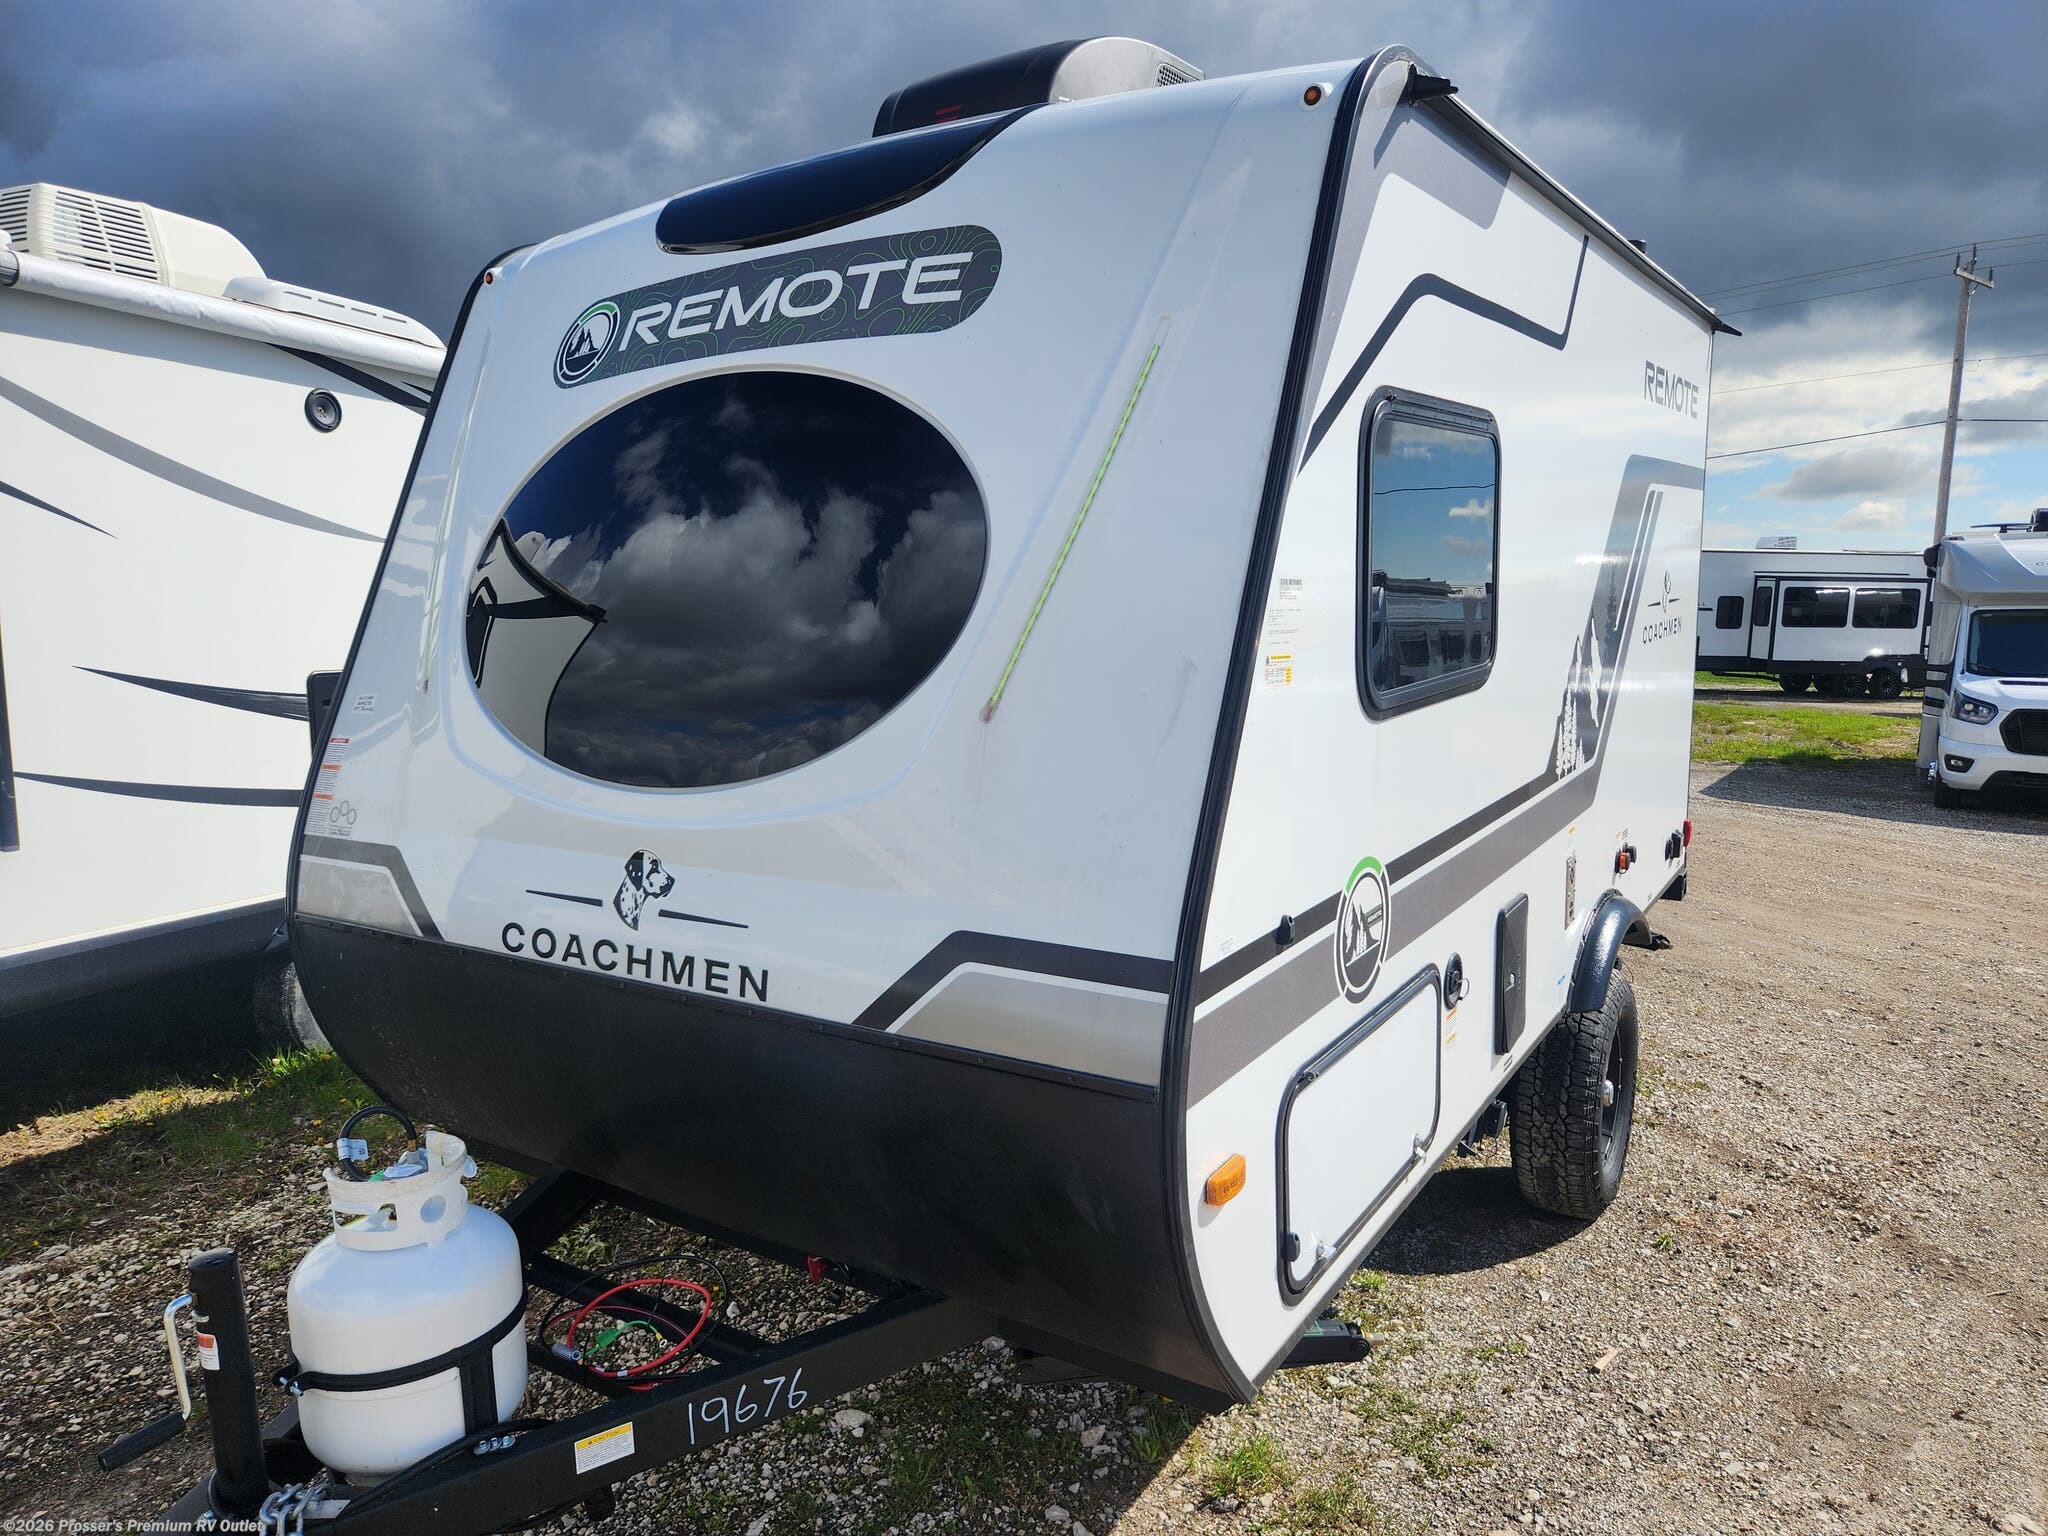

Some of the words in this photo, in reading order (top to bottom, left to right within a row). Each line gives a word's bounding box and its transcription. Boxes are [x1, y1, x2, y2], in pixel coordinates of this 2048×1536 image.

[618, 252, 974, 352] REMOTE
[1643, 360, 1699, 420] REMOTE
[1642, 616, 1682, 645] COACHMEN
[501, 922, 769, 1002] COACHMEN
[594, 1430, 619, 1442] CAUTION
[688, 1367, 808, 1446] 19676
